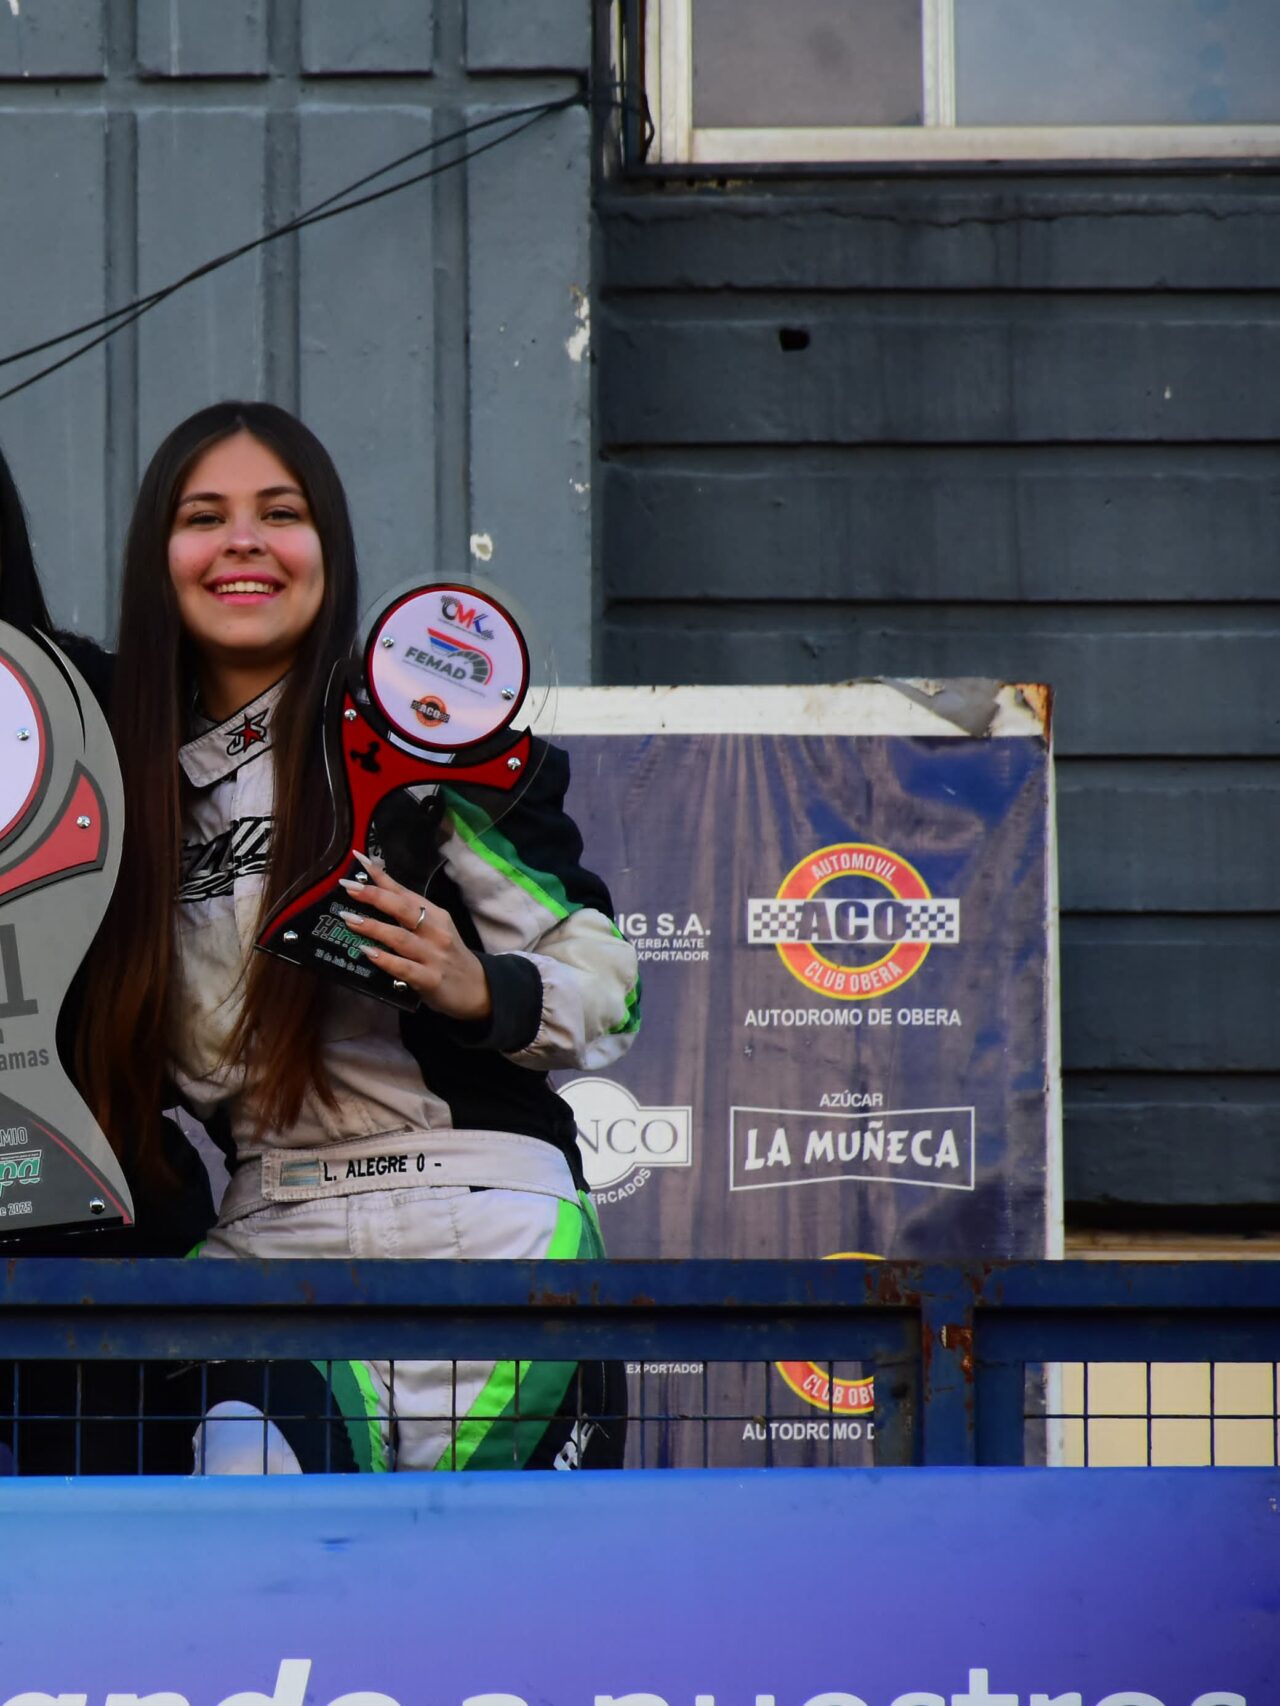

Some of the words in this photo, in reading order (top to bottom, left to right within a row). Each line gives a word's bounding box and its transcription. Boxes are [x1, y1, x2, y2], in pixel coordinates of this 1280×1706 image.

[404, 646, 467, 682] FEMAD
[811, 853, 898, 881] AUTOMOVIL
[656, 913, 711, 936] S.A.
[797, 900, 910, 941] ACO
[673, 939, 705, 948] MATE
[637, 951, 709, 960] XPORTADOR
[805, 961, 845, 990] CLUB
[850, 961, 904, 992] OBERA
[744, 1008, 863, 1026] AUTODROMO
[867, 1008, 893, 1025] DE
[897, 1008, 962, 1026] OBERA
[819, 1089, 884, 1108] AZÚCAR
[744, 1127, 791, 1171] LA
[804, 1120, 960, 1168] MUÑECA
[323, 1161, 337, 1181] L.
[345, 1155, 407, 1179] ALEGRE
[8, 1201, 32, 1215] 2025
[742, 1423, 862, 1440] AUTODROMO
